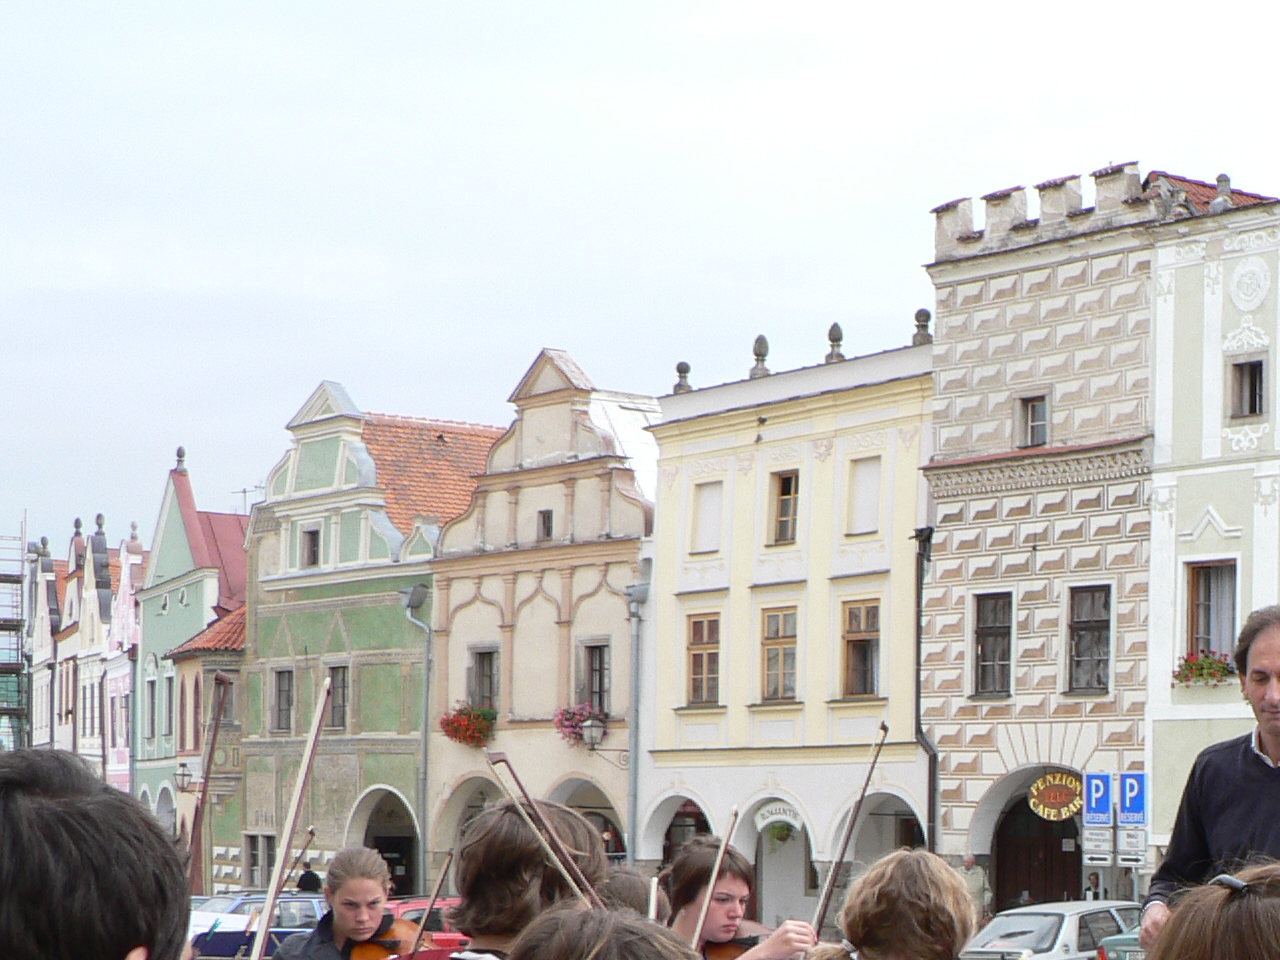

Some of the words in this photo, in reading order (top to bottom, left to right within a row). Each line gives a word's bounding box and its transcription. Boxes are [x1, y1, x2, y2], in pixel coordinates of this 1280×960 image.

[1030, 772, 1082, 796] PENZION
[1091, 778, 1104, 808] P
[1125, 777, 1139, 808] P
[1061, 796, 1083, 818] BAR
